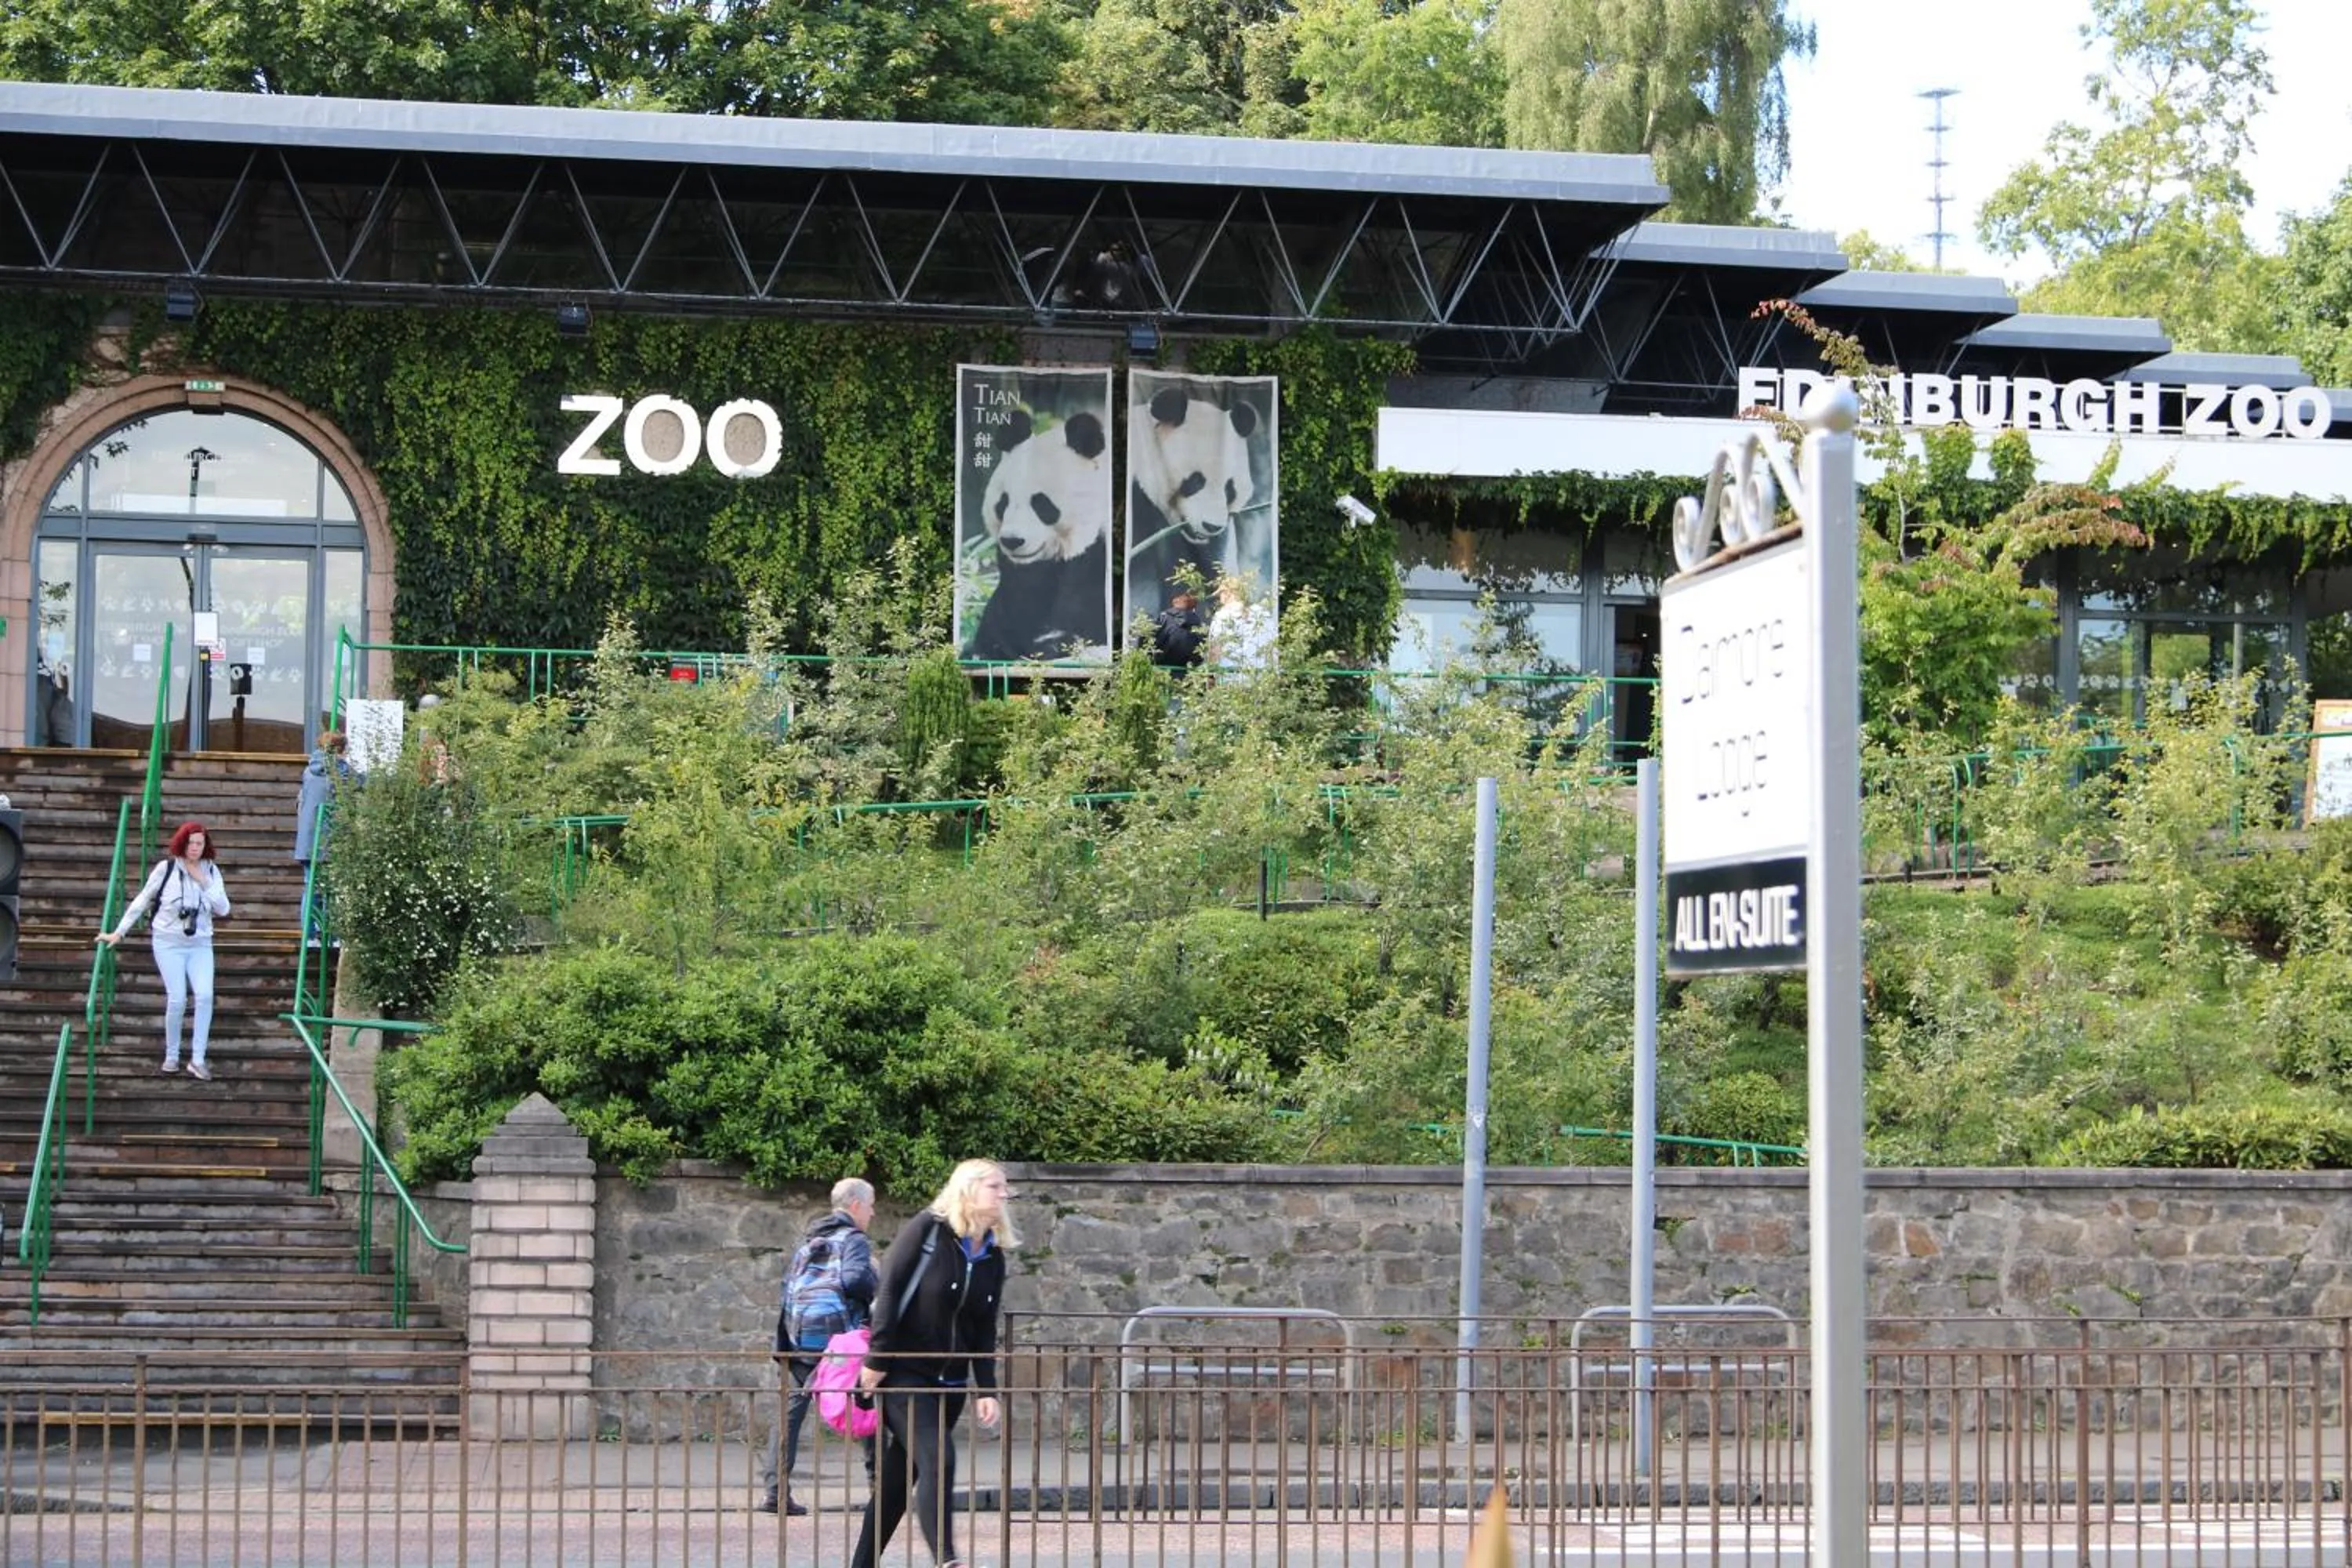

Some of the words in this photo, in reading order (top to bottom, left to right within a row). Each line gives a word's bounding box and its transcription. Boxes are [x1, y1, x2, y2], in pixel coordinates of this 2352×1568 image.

[557, 394, 783, 478] ZOO
[1738, 366, 2160, 434] EDNBURGH
[2184, 383, 2332, 439] ZOO
[1674, 895, 1708, 952] ALL
[1708, 884, 1800, 950] EN-SUITE
